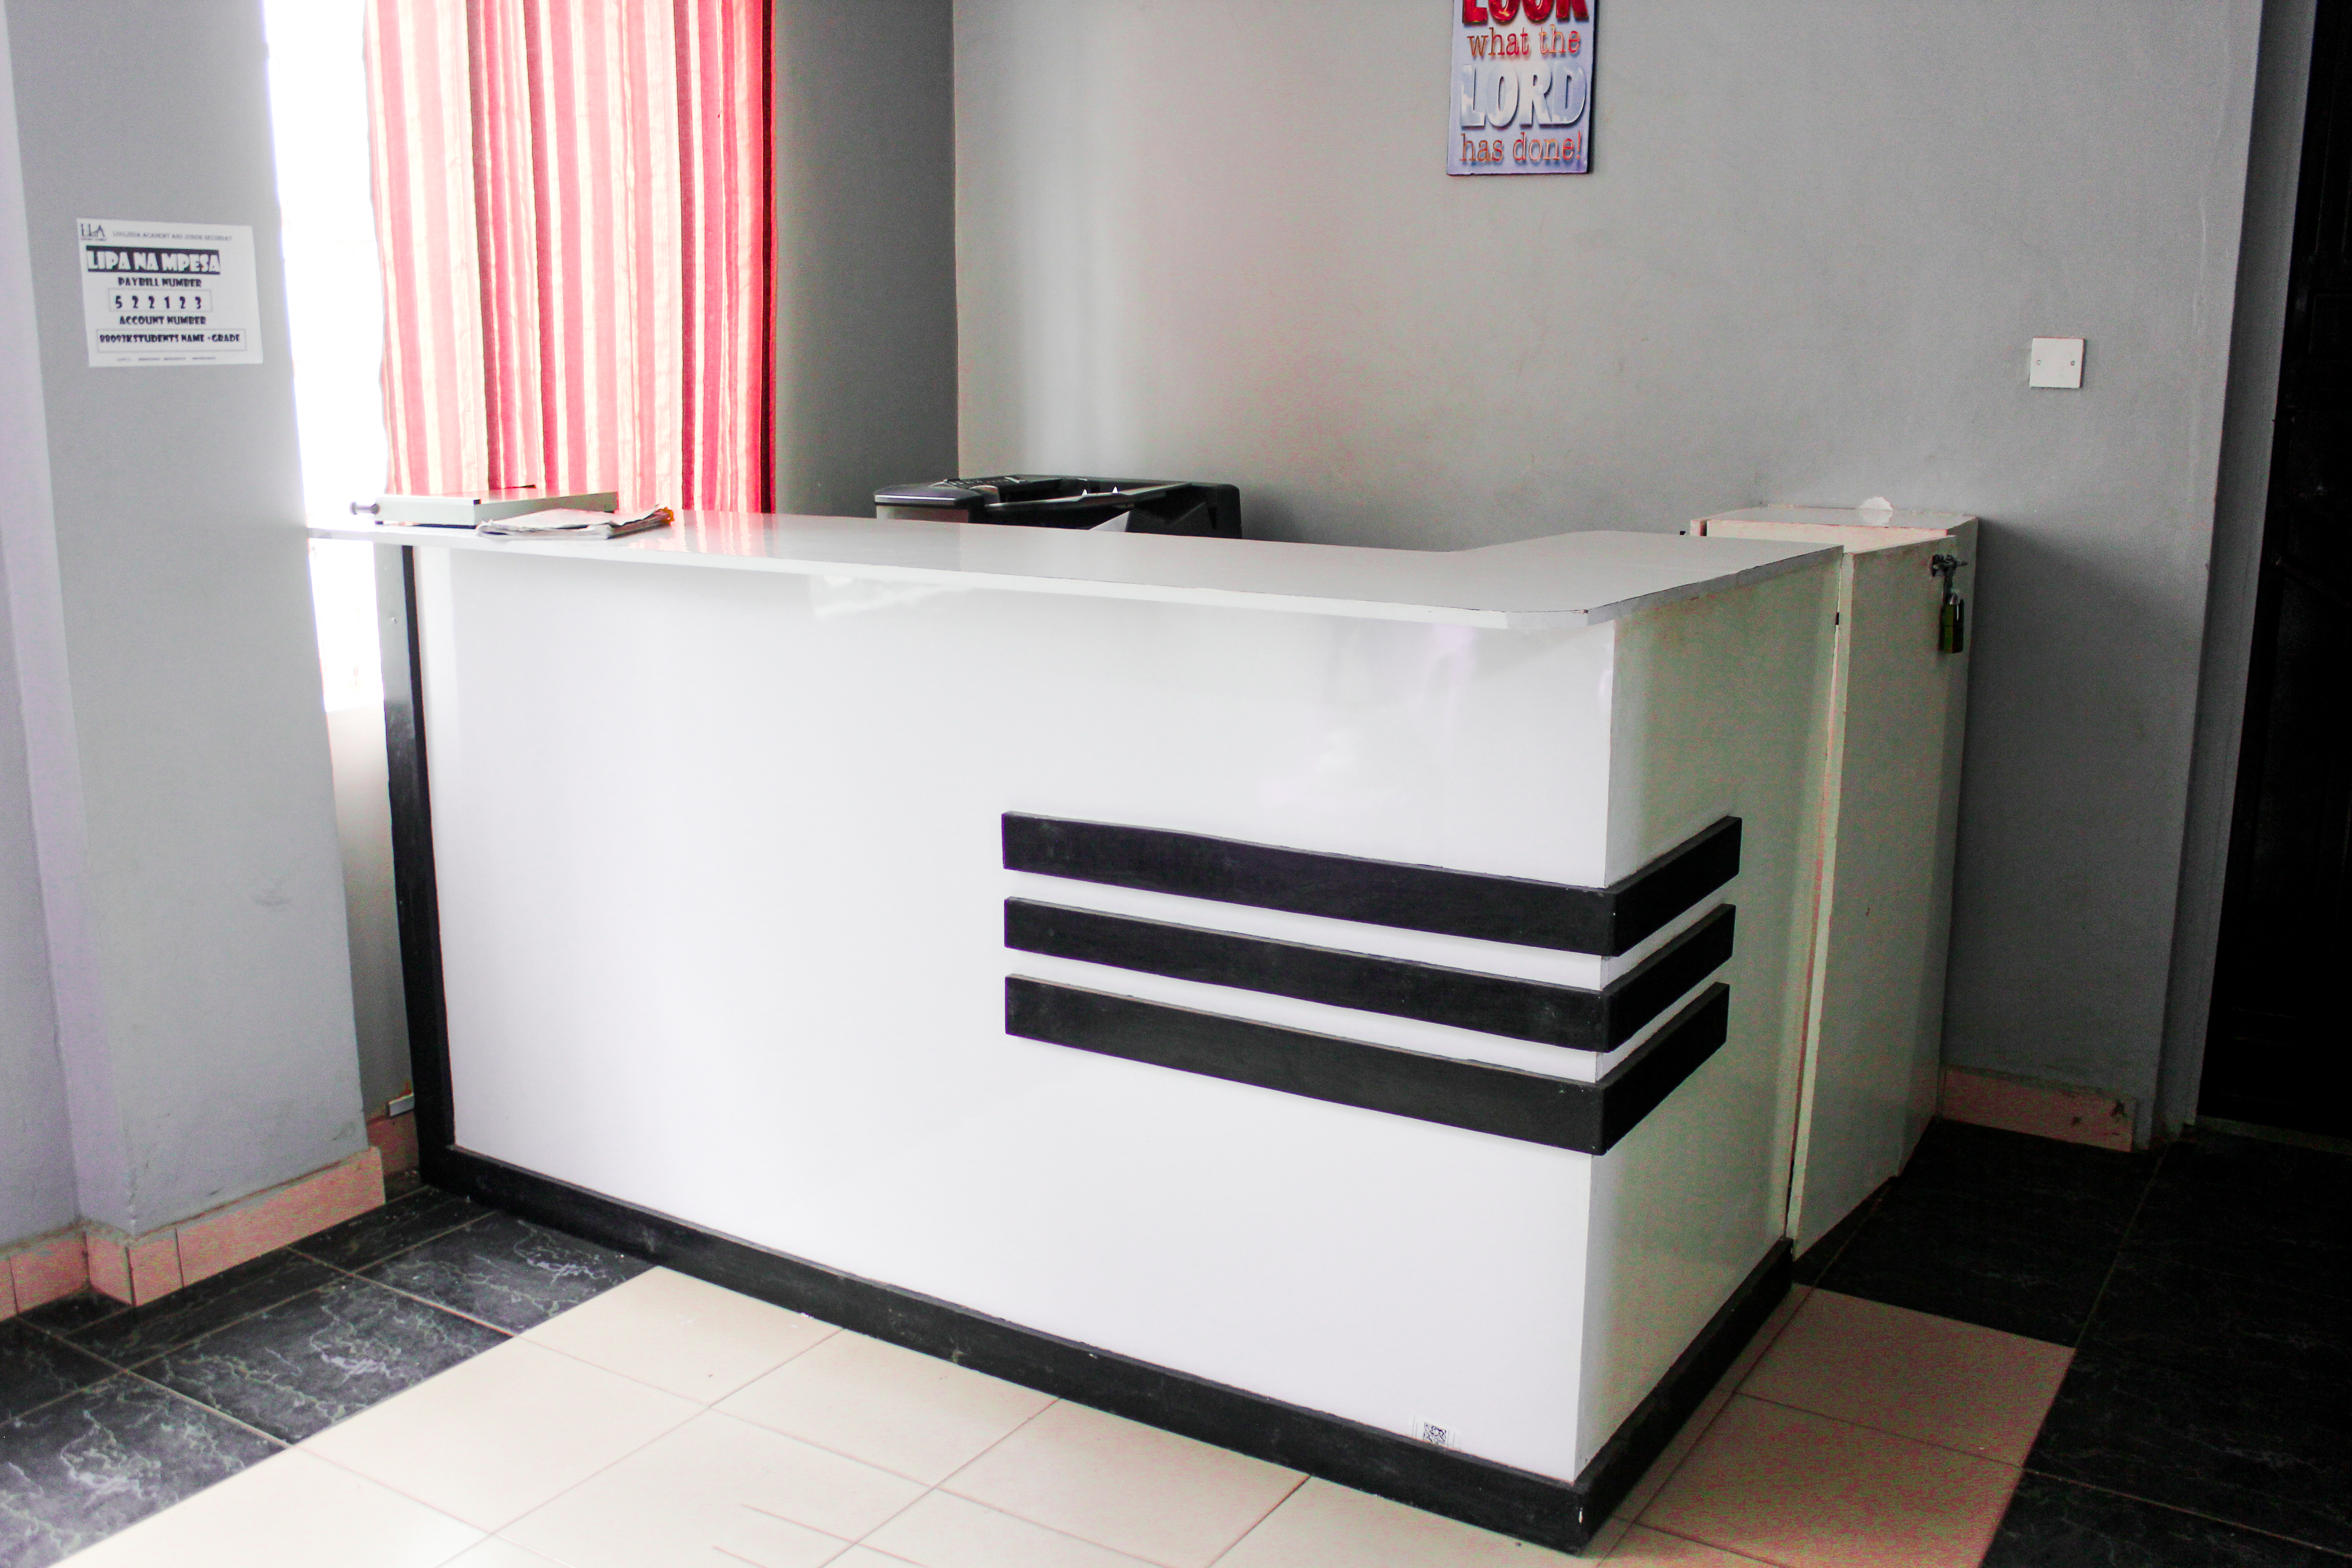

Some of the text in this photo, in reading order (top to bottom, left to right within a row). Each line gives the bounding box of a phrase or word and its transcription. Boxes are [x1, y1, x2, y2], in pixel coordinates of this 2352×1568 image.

[1467, 24, 1581, 57] what the
[1460, 60, 1587, 129] LORD
[1460, 131, 1582, 162] has done!
[87, 250, 220, 272] LIPA NA MPESA
[118, 277, 202, 287] PAYBILL NUMBER
[120, 316, 206, 324] ACCOUNT NUMBER
[181, 333, 204, 342] NAME
